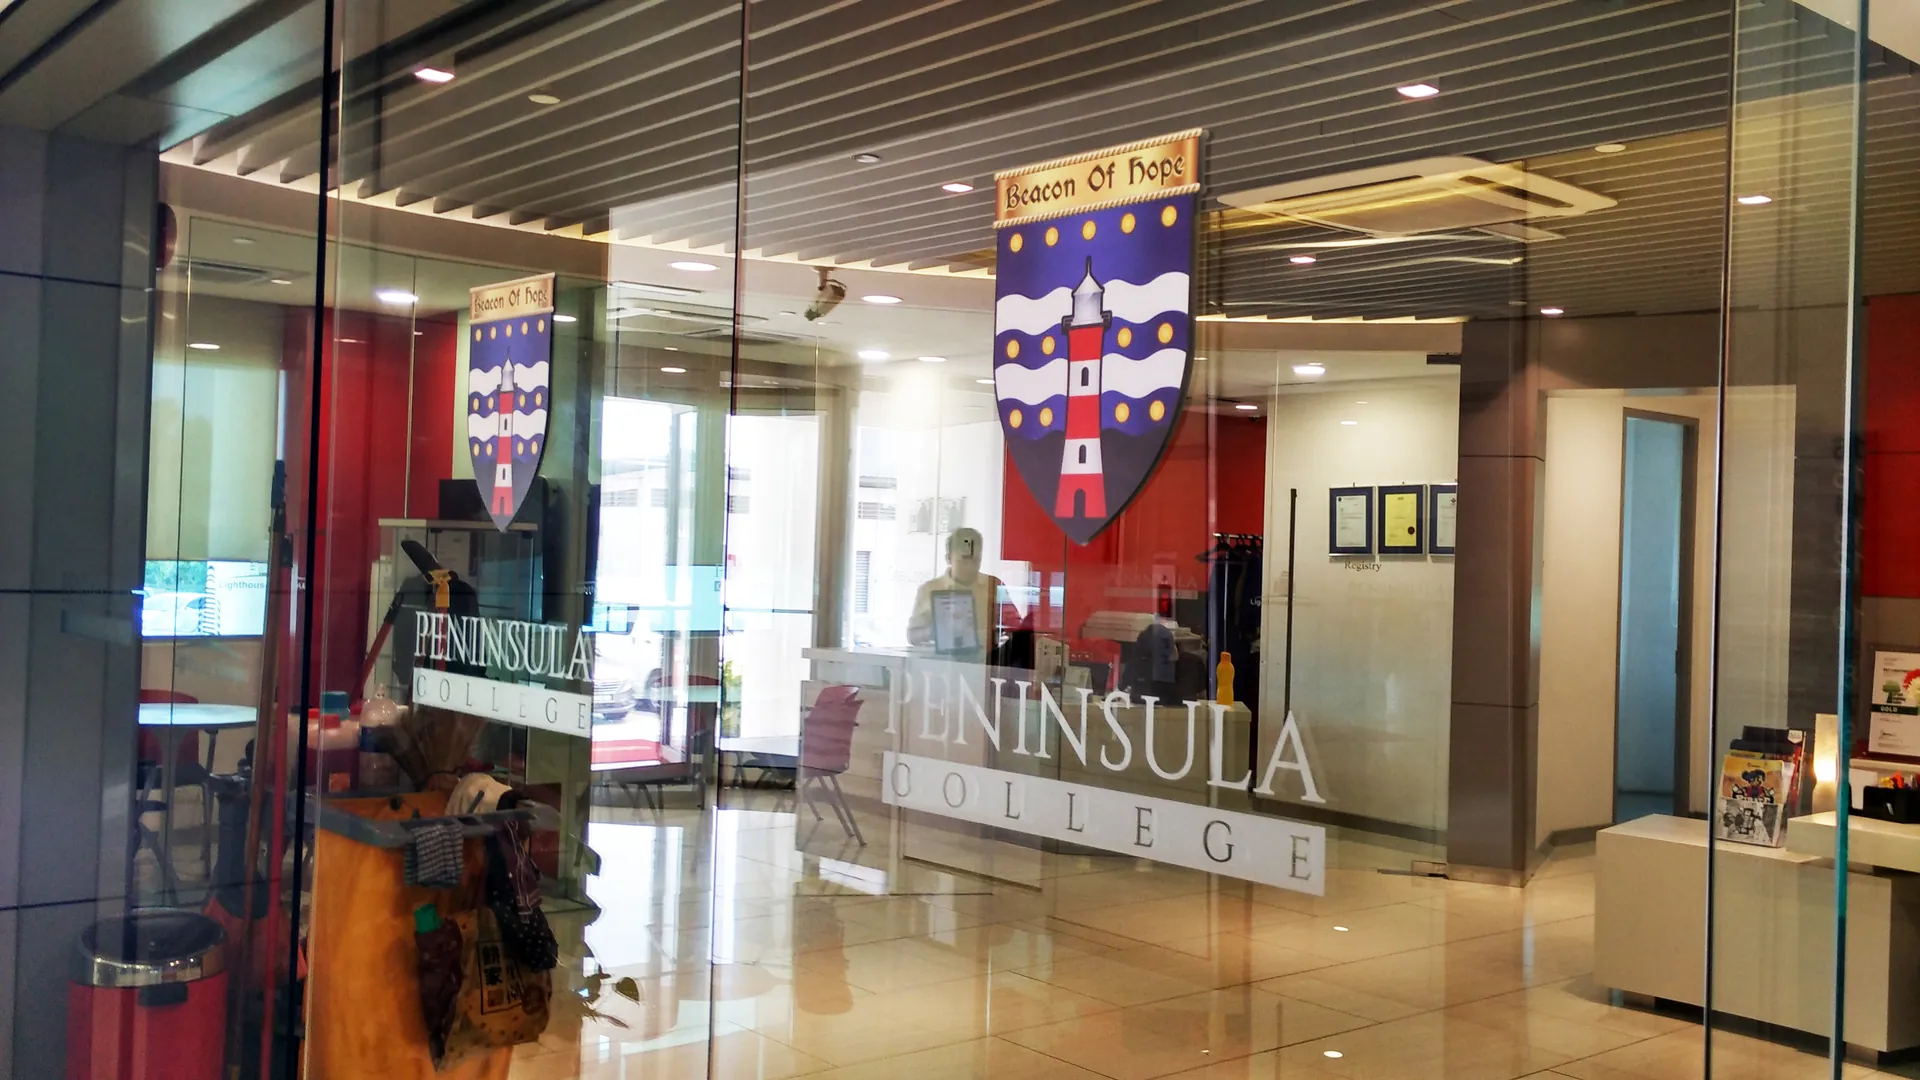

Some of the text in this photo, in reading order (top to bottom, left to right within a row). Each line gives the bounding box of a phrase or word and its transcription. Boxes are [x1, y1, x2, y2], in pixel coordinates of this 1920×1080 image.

[1006, 155, 1184, 209] Beacon Of Hope
[474, 286, 548, 312] Beacon Of Hope
[1344, 561, 1382, 572] Registry
[414, 610, 593, 683] PENINSULA
[416, 675, 587, 730] COLLEGE
[1880, 705, 1898, 713] GOLD
[883, 666, 1327, 803] PENINSULA
[890, 761, 1312, 882] COLLEGE
